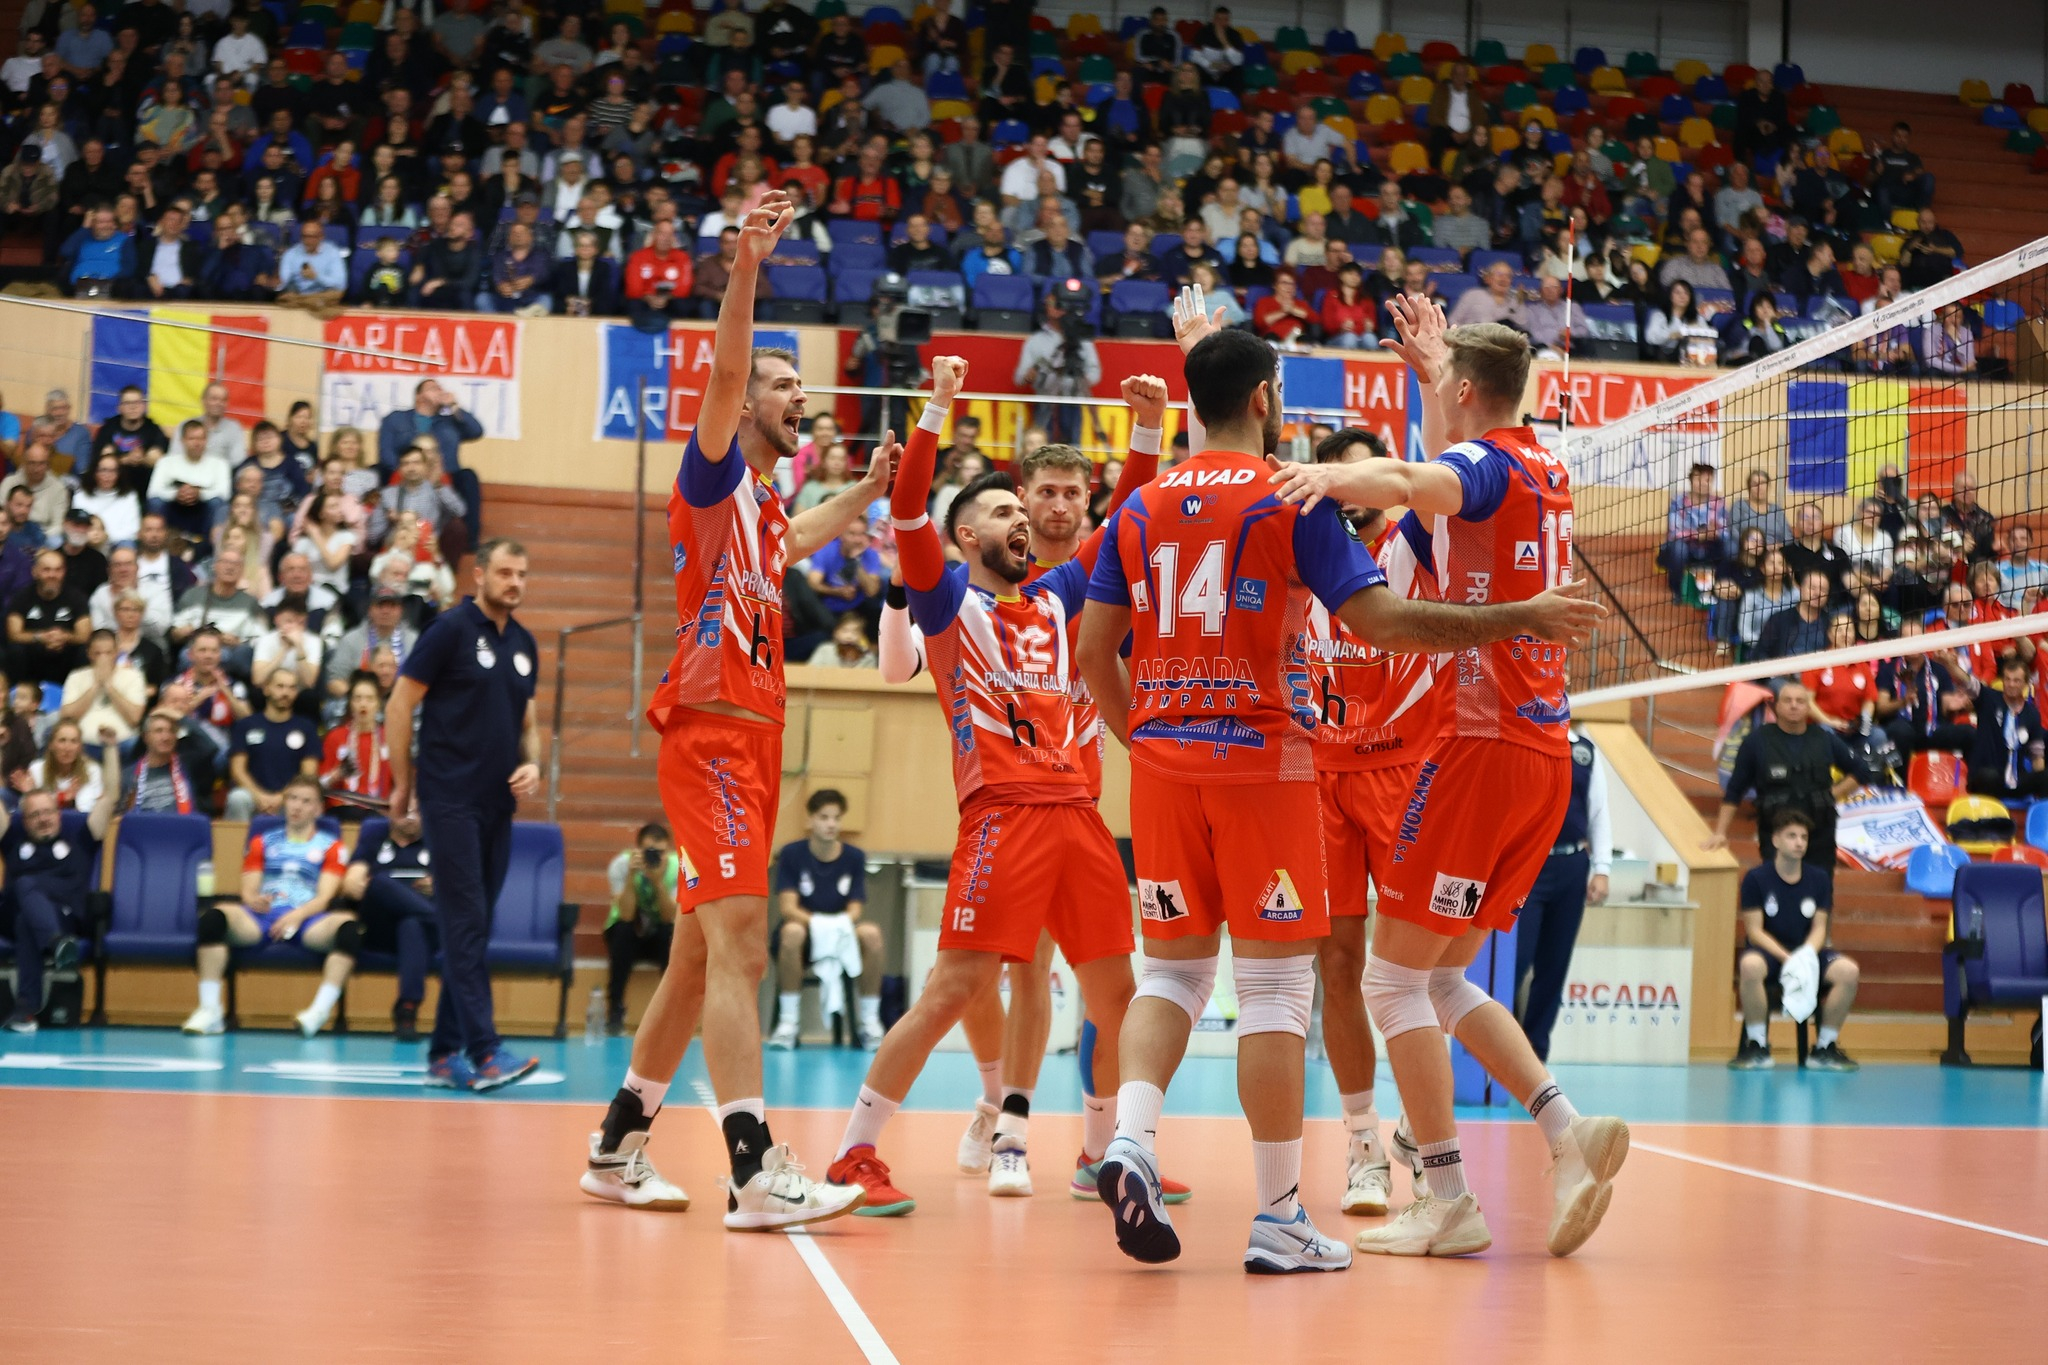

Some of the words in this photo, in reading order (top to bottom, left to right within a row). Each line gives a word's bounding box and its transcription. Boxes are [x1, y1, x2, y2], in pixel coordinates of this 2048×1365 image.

[332, 323, 512, 377] ARCADA
[653, 336, 715, 372] HA
[603, 386, 700, 431] ARC
[1159, 469, 1256, 488] JAVAD
[696, 552, 729, 648] amiro
[1150, 540, 1227, 638] 14
[1236, 595, 1262, 605] UNIQA
[1007, 623, 1053, 664] 12
[1137, 657, 1258, 691] ARCADA
[1130, 693, 1260, 710] COMPANY
[1354, 738, 1404, 754] consult
[698, 758, 738, 847] ARCADA
[1398, 759, 1440, 844] NAVROM
[718, 853, 736, 878] 5
[1392, 843, 1408, 864] S.A.
[1258, 881, 1277, 907] GALATI
[1323, 888, 1330, 917] 1
[1434, 895, 1459, 908] AMIRO
[952, 906, 975, 932] 12
[1267, 911, 1298, 919] ARCADA
[1432, 903, 1457, 915] EVENTS
[1567, 983, 1680, 1010] RCADA
[1563, 1014, 1681, 1026] OMPANY
[1423, 1154, 1460, 1166] DICKIES
